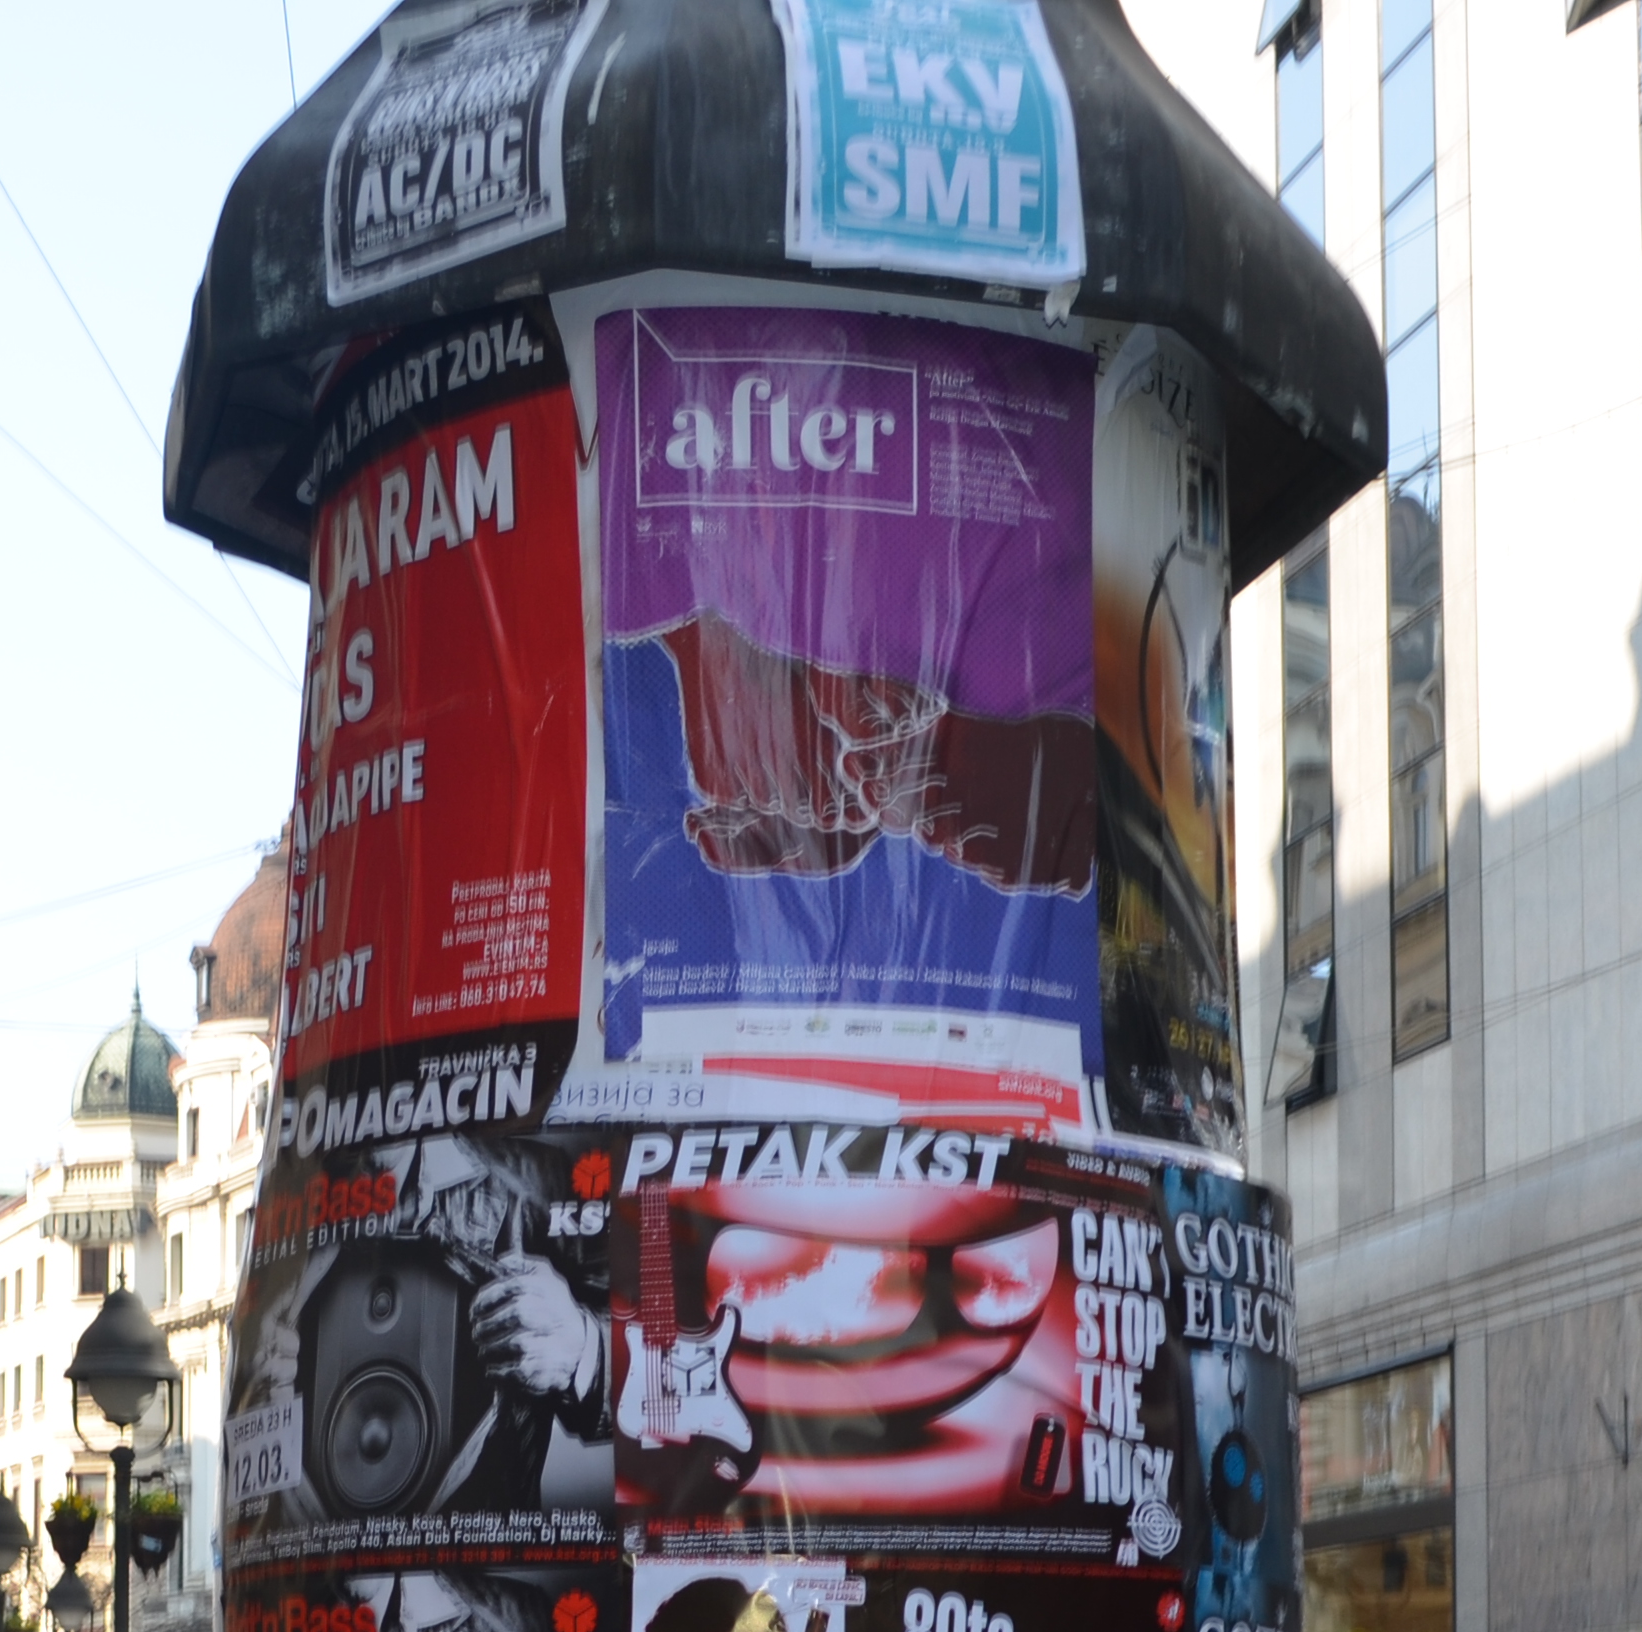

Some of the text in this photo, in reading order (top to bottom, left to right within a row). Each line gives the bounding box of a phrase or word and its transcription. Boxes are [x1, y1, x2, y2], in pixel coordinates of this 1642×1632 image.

[838, 39, 1023, 134] EKV
[355, 116, 523, 232] AC/DC
[844, 131, 1041, 236] SMF
[367, 343, 443, 428] MART
[447, 311, 544, 391] 2014.
[665, 376, 897, 476] after
[620, 1123, 1012, 1196] PETAK KST
[306, 1210, 395, 1251] EDITION
[548, 1202, 609, 1237] KS
[1074, 1282, 1167, 1371] STOP
[1075, 1356, 1144, 1441] THE
[231, 1447, 290, 1498] 12.03.
[1081, 1429, 1175, 1506] ROCK
[365, 1516, 407, 1537] Netsky,
[449, 1512, 503, 1533] Prodigy,
[508, 1511, 547, 1529] Nero,
[551, 1510, 602, 1528] Rusko,
[454, 1528, 537, 1546] Foundation,
